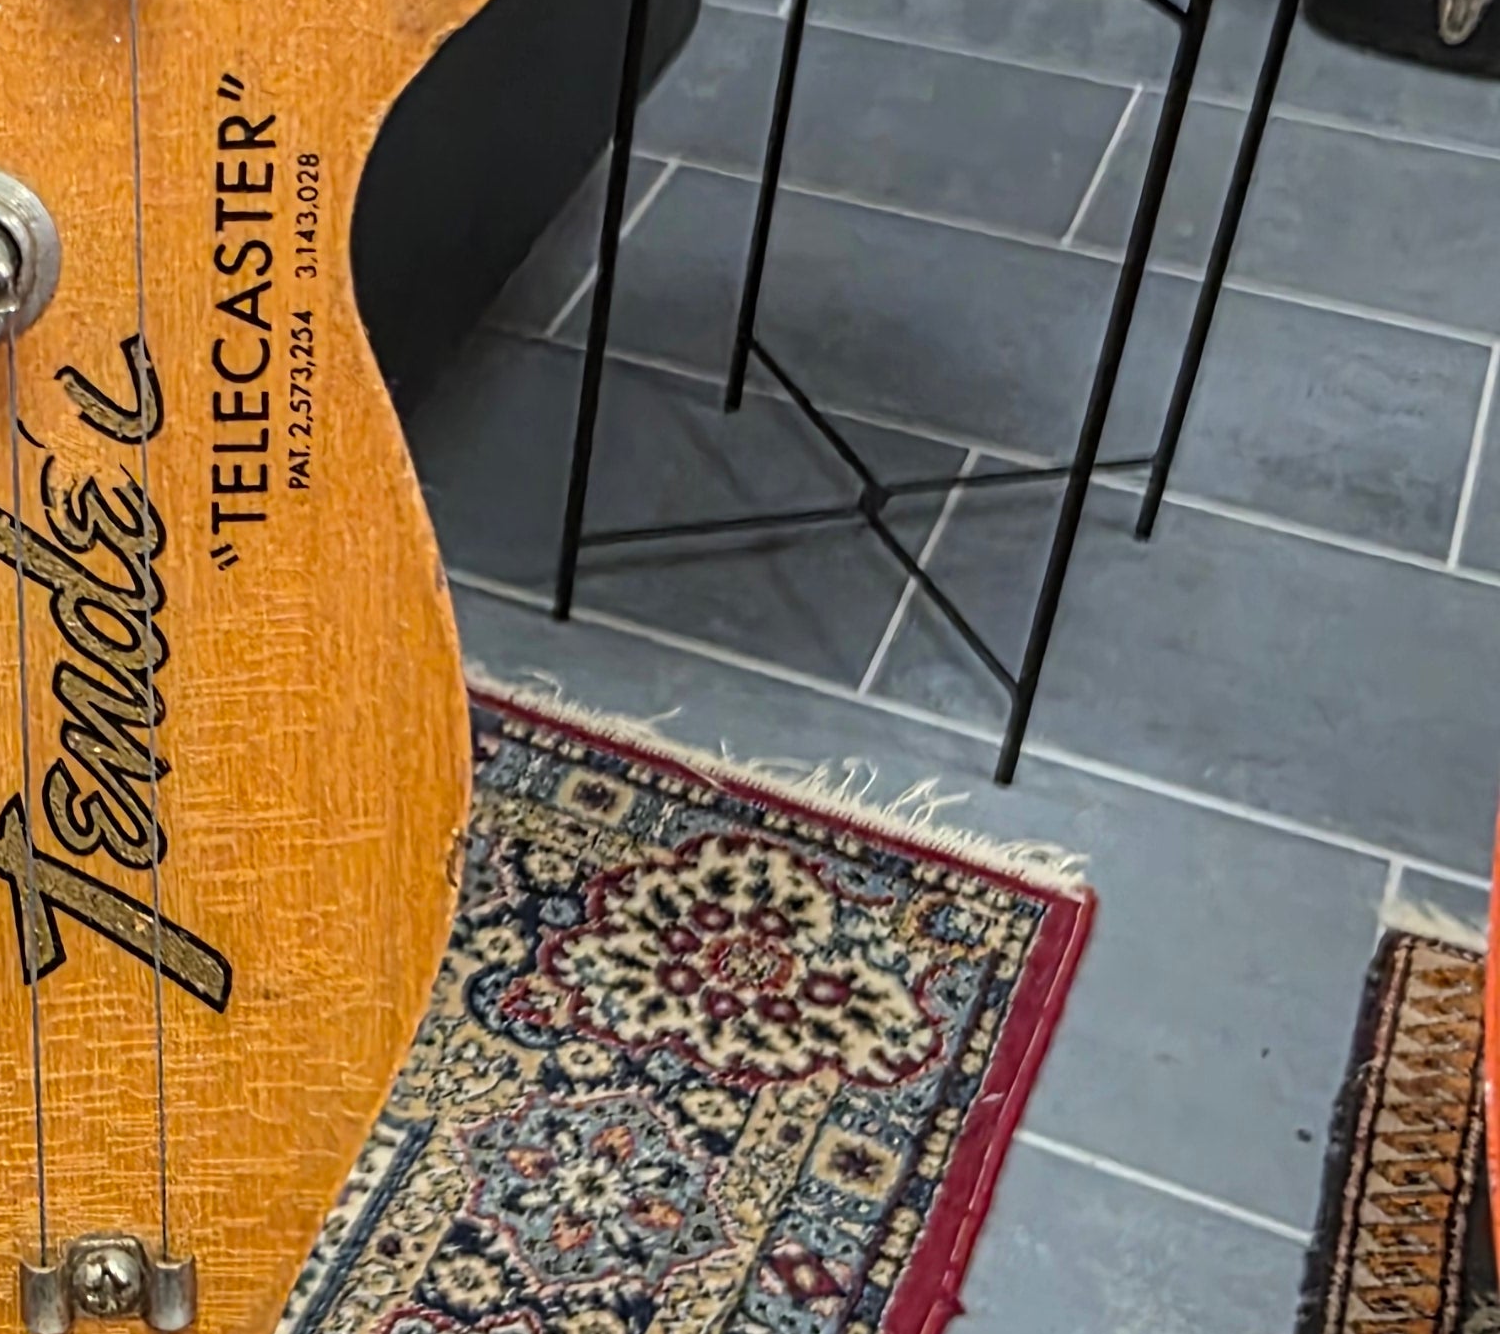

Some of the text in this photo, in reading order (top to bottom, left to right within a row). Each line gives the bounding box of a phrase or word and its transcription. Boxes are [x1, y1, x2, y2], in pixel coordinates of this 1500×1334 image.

[210, 73, 276, 571] "TELECASTER"
[288, 153, 320, 490] PAT. 2,573,254 3,143,028
